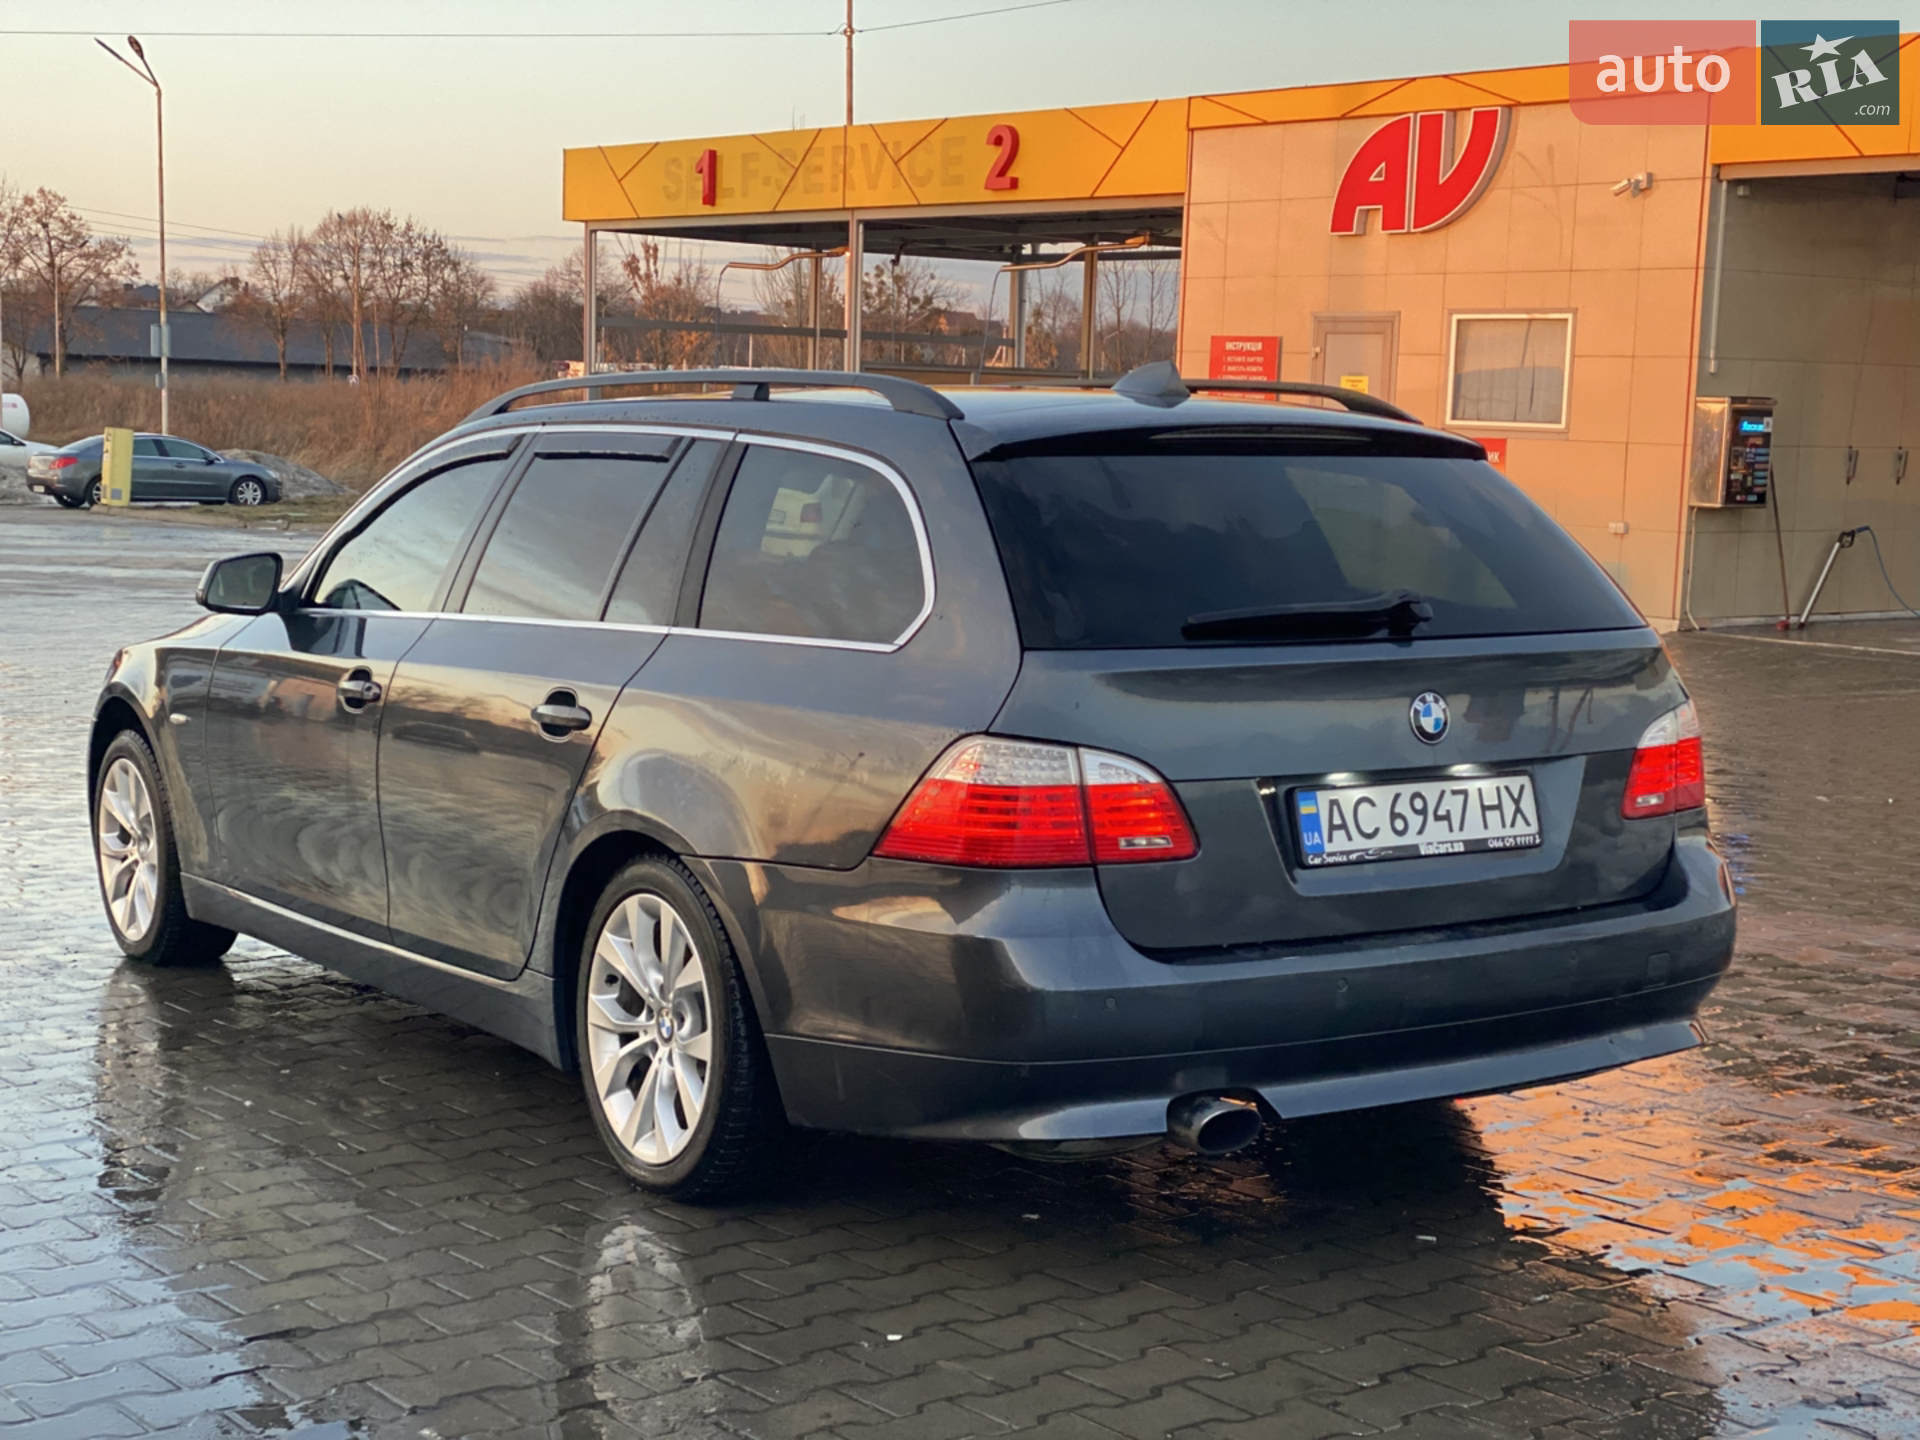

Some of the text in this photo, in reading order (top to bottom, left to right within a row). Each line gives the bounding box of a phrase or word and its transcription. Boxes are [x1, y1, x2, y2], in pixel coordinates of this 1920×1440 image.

[694, 148, 718, 207] 1
[984, 123, 1021, 191] 2
[1329, 107, 1511, 236] AV
[1303, 832, 1322, 846] UA
[1327, 783, 1532, 844] AC 6947 HX
